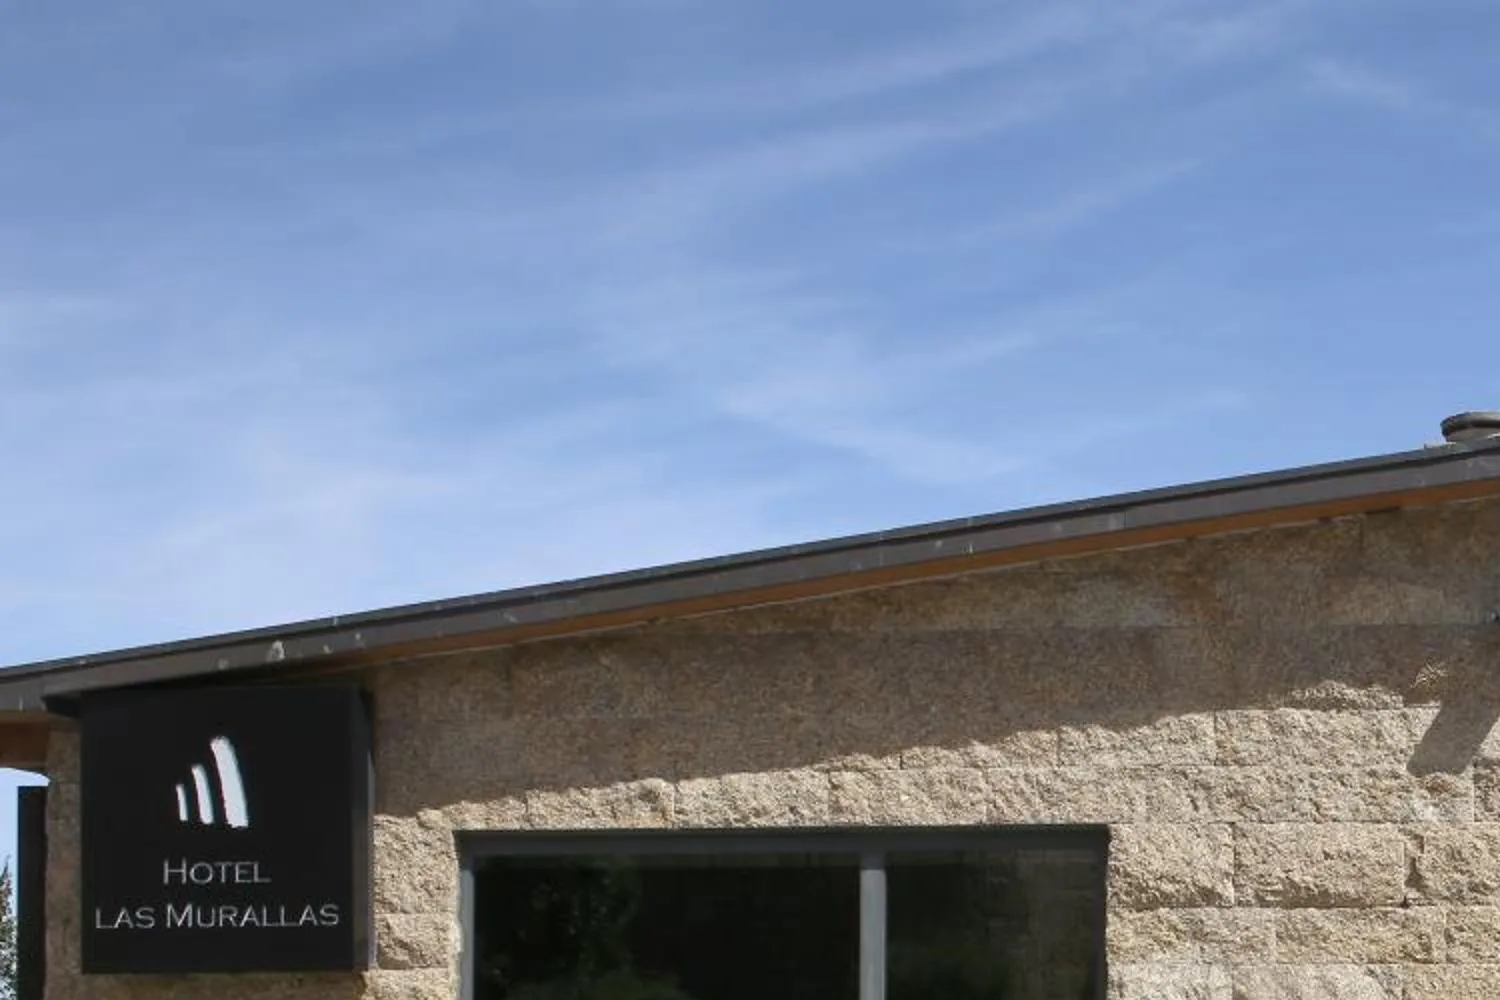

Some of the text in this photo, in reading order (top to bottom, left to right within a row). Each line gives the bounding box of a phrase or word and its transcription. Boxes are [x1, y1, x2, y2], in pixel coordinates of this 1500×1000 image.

[163, 857, 272, 885] HOTEL
[95, 902, 340, 929] LAS MURALLAS
